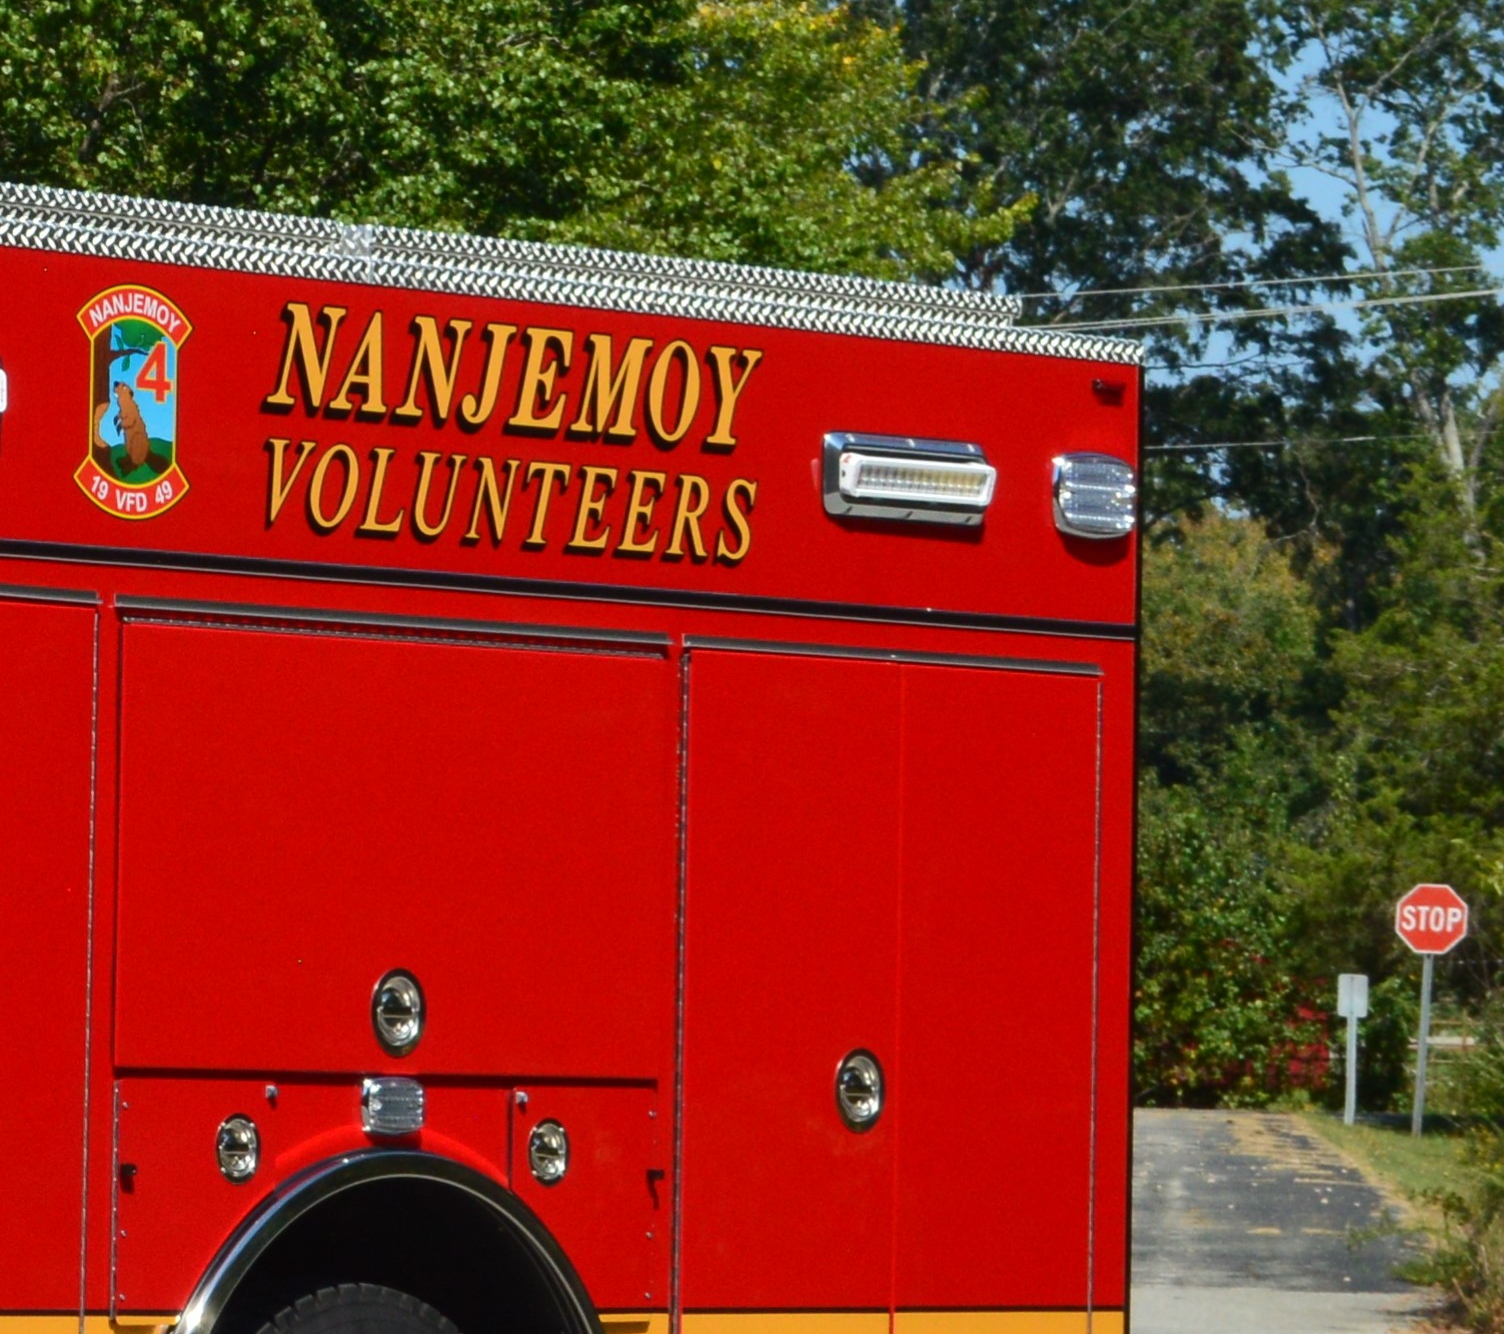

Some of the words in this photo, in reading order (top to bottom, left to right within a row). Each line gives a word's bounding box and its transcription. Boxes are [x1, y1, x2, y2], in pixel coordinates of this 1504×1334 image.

[89, 292, 182, 334] NANJEMOY
[135, 341, 172, 404] 4
[264, 301, 763, 450] NANJEMOY
[91, 475, 109, 501] 19
[115, 488, 148, 513] VFD
[154, 480, 174, 505] 49
[266, 437, 759, 564] VOLUNTEERS
[1401, 905, 1463, 932] STOP
